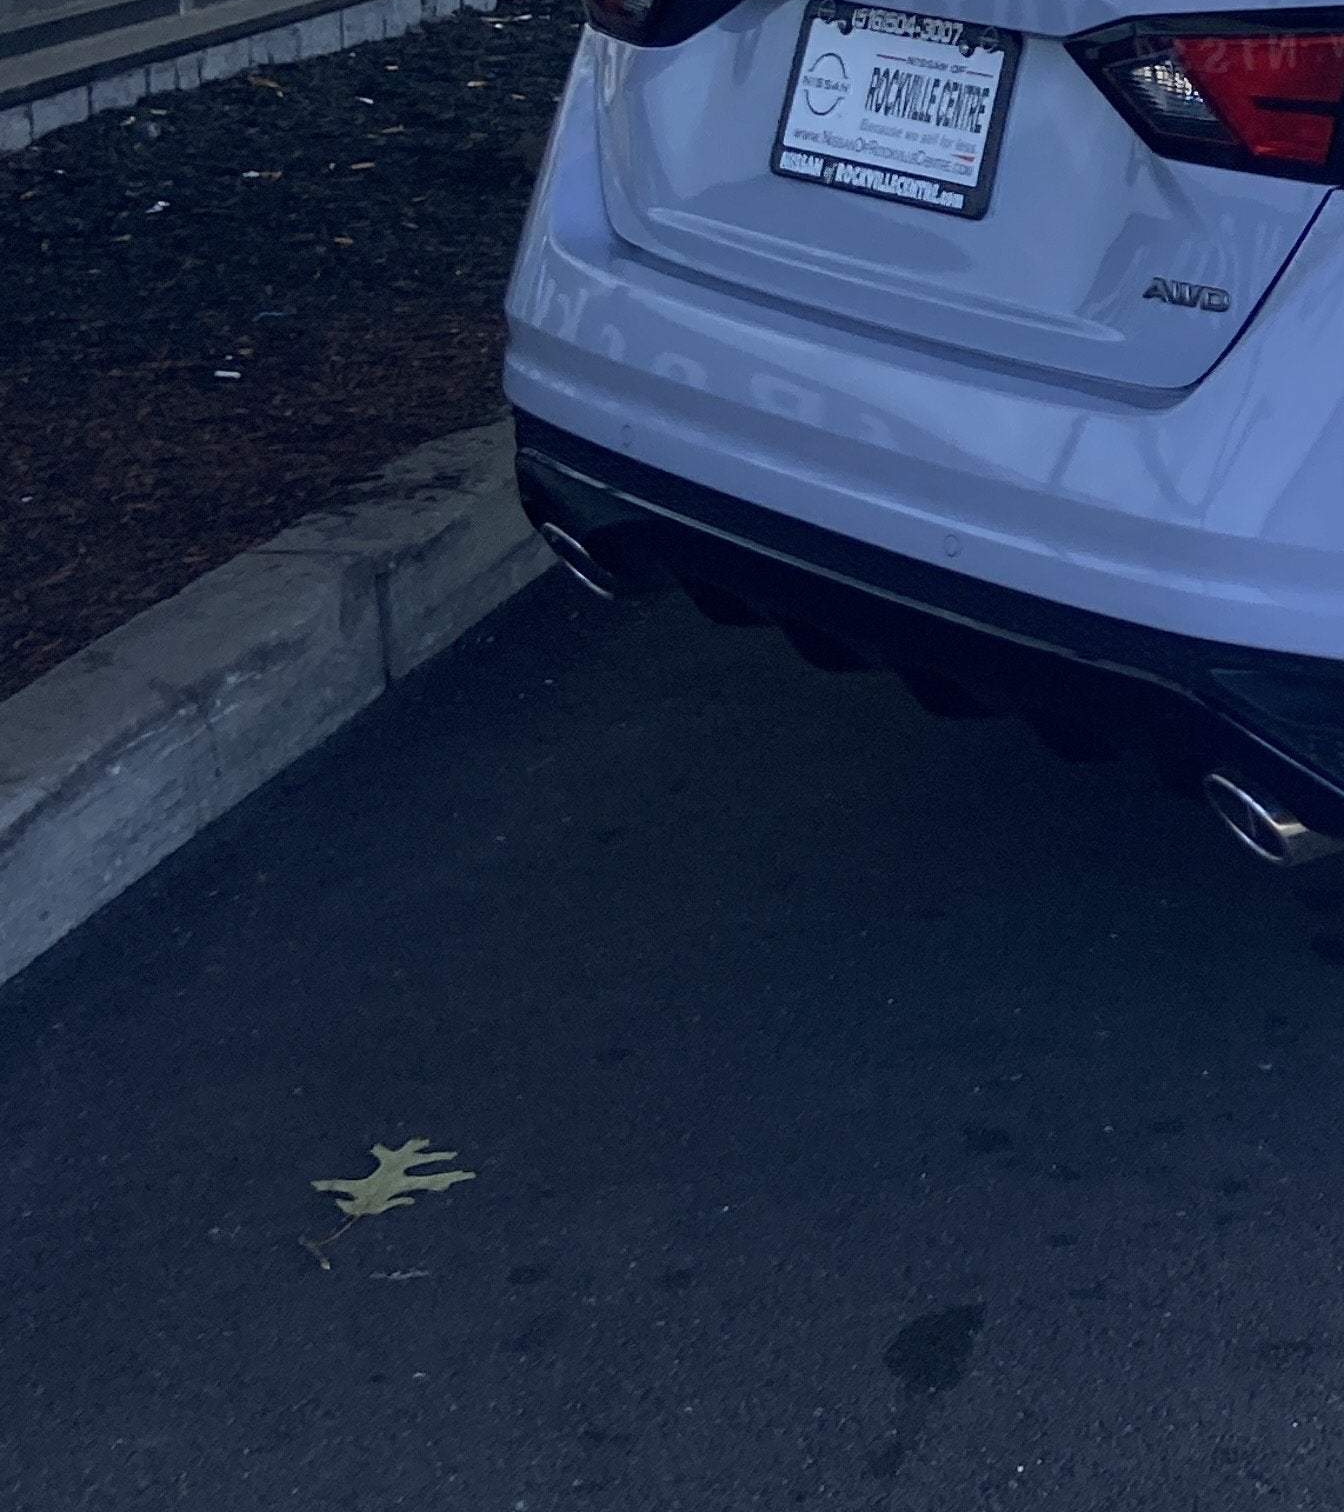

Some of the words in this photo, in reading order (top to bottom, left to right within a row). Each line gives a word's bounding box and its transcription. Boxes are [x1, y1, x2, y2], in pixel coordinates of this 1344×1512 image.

[802, 75, 850, 93] NISSAN
[865, 67, 940, 123] ROCKVILLE
[935, 79, 990, 134] CENTRE
[1142, 276, 1232, 312] AWD
